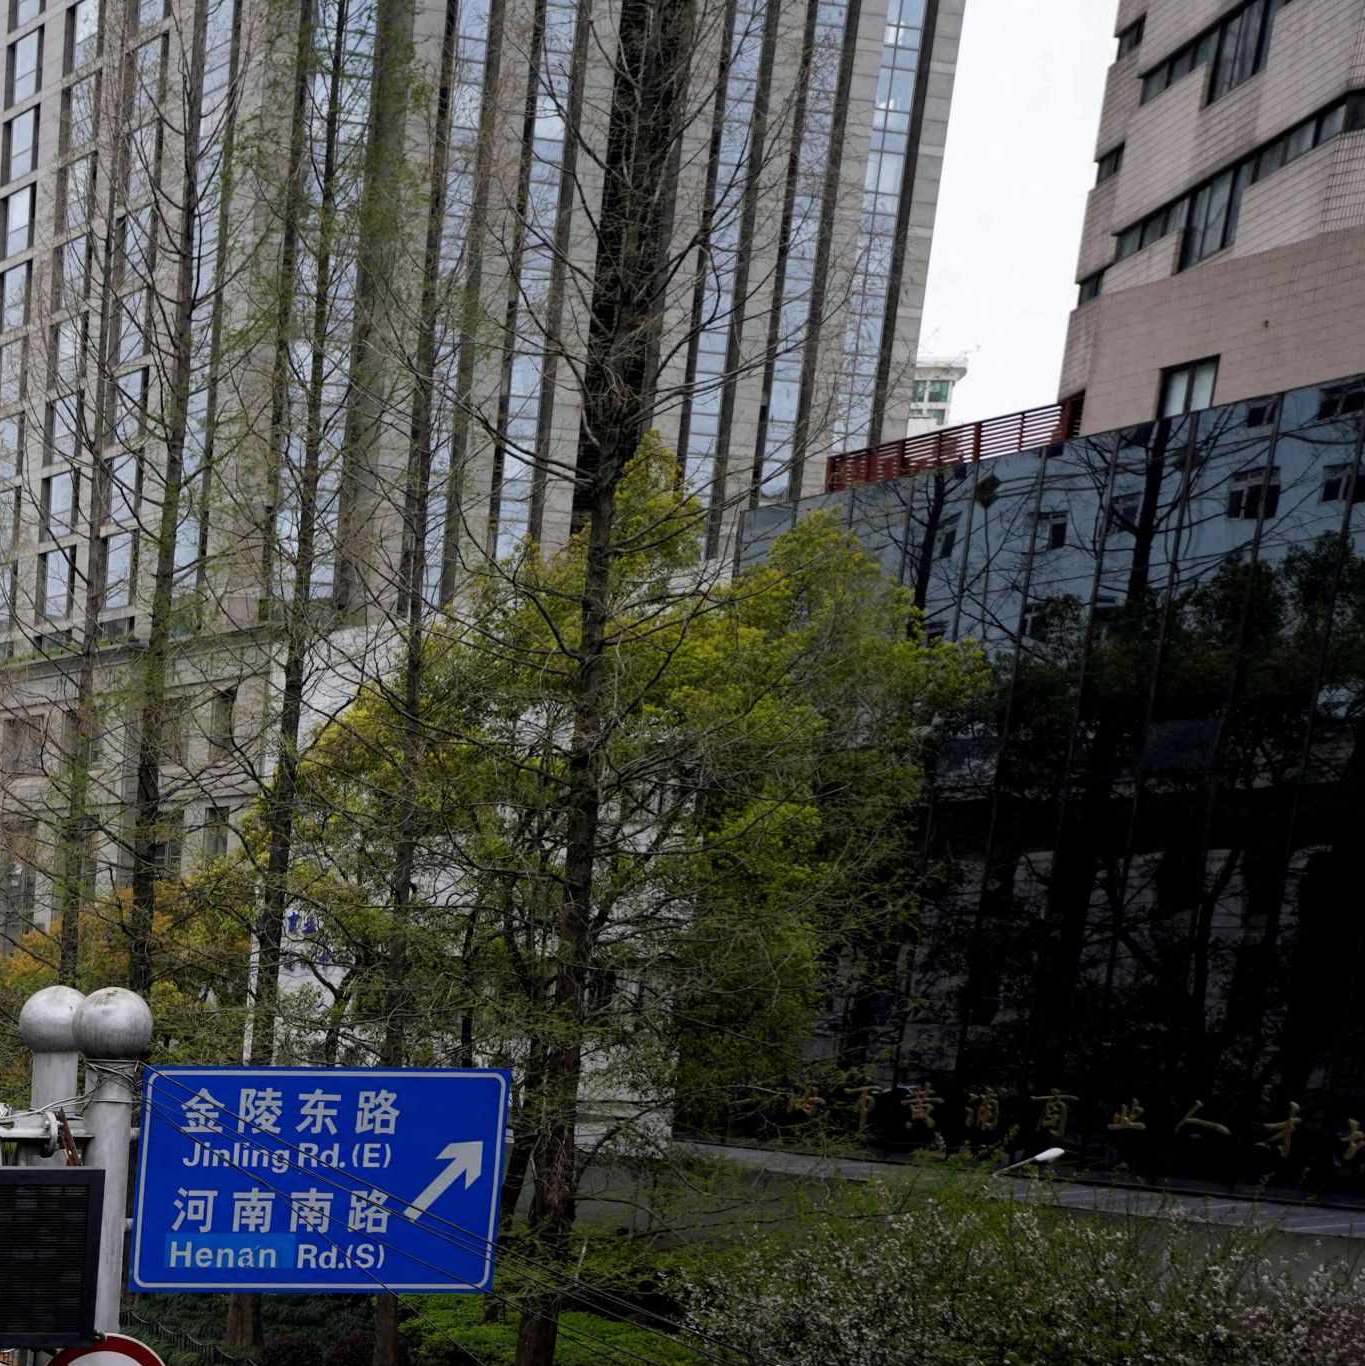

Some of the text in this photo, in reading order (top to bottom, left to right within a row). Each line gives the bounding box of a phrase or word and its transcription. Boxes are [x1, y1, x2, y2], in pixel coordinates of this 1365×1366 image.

[180, 1087, 401, 1136] 金陵东路
[183, 1142, 290, 1174] Jinling
[172, 1187, 391, 1234] 河南南路
[169, 1240, 278, 1269] Henan
